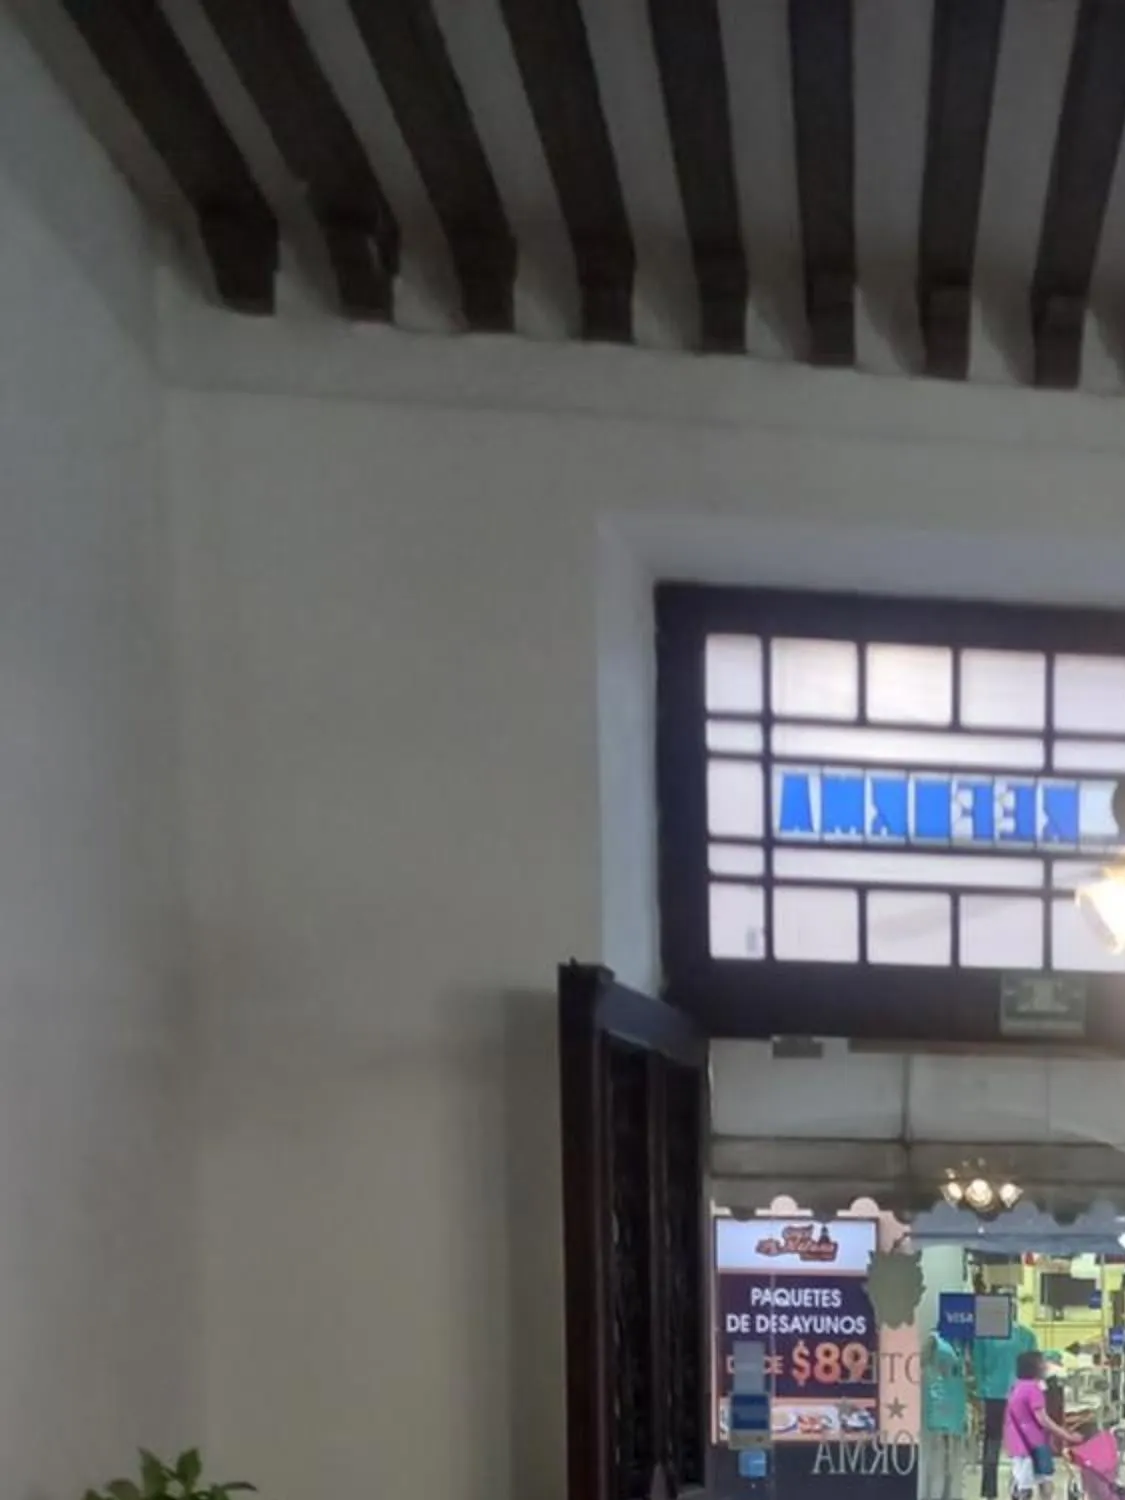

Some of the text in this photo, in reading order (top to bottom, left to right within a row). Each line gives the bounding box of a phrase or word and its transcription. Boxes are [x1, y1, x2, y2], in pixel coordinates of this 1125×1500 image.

[750, 1287, 842, 1308] PAQUETES
[725, 1313, 868, 1335] DE DESAYUNOS
[944, 1311, 973, 1325] VISA
[790, 1339, 869, 1387] $89
